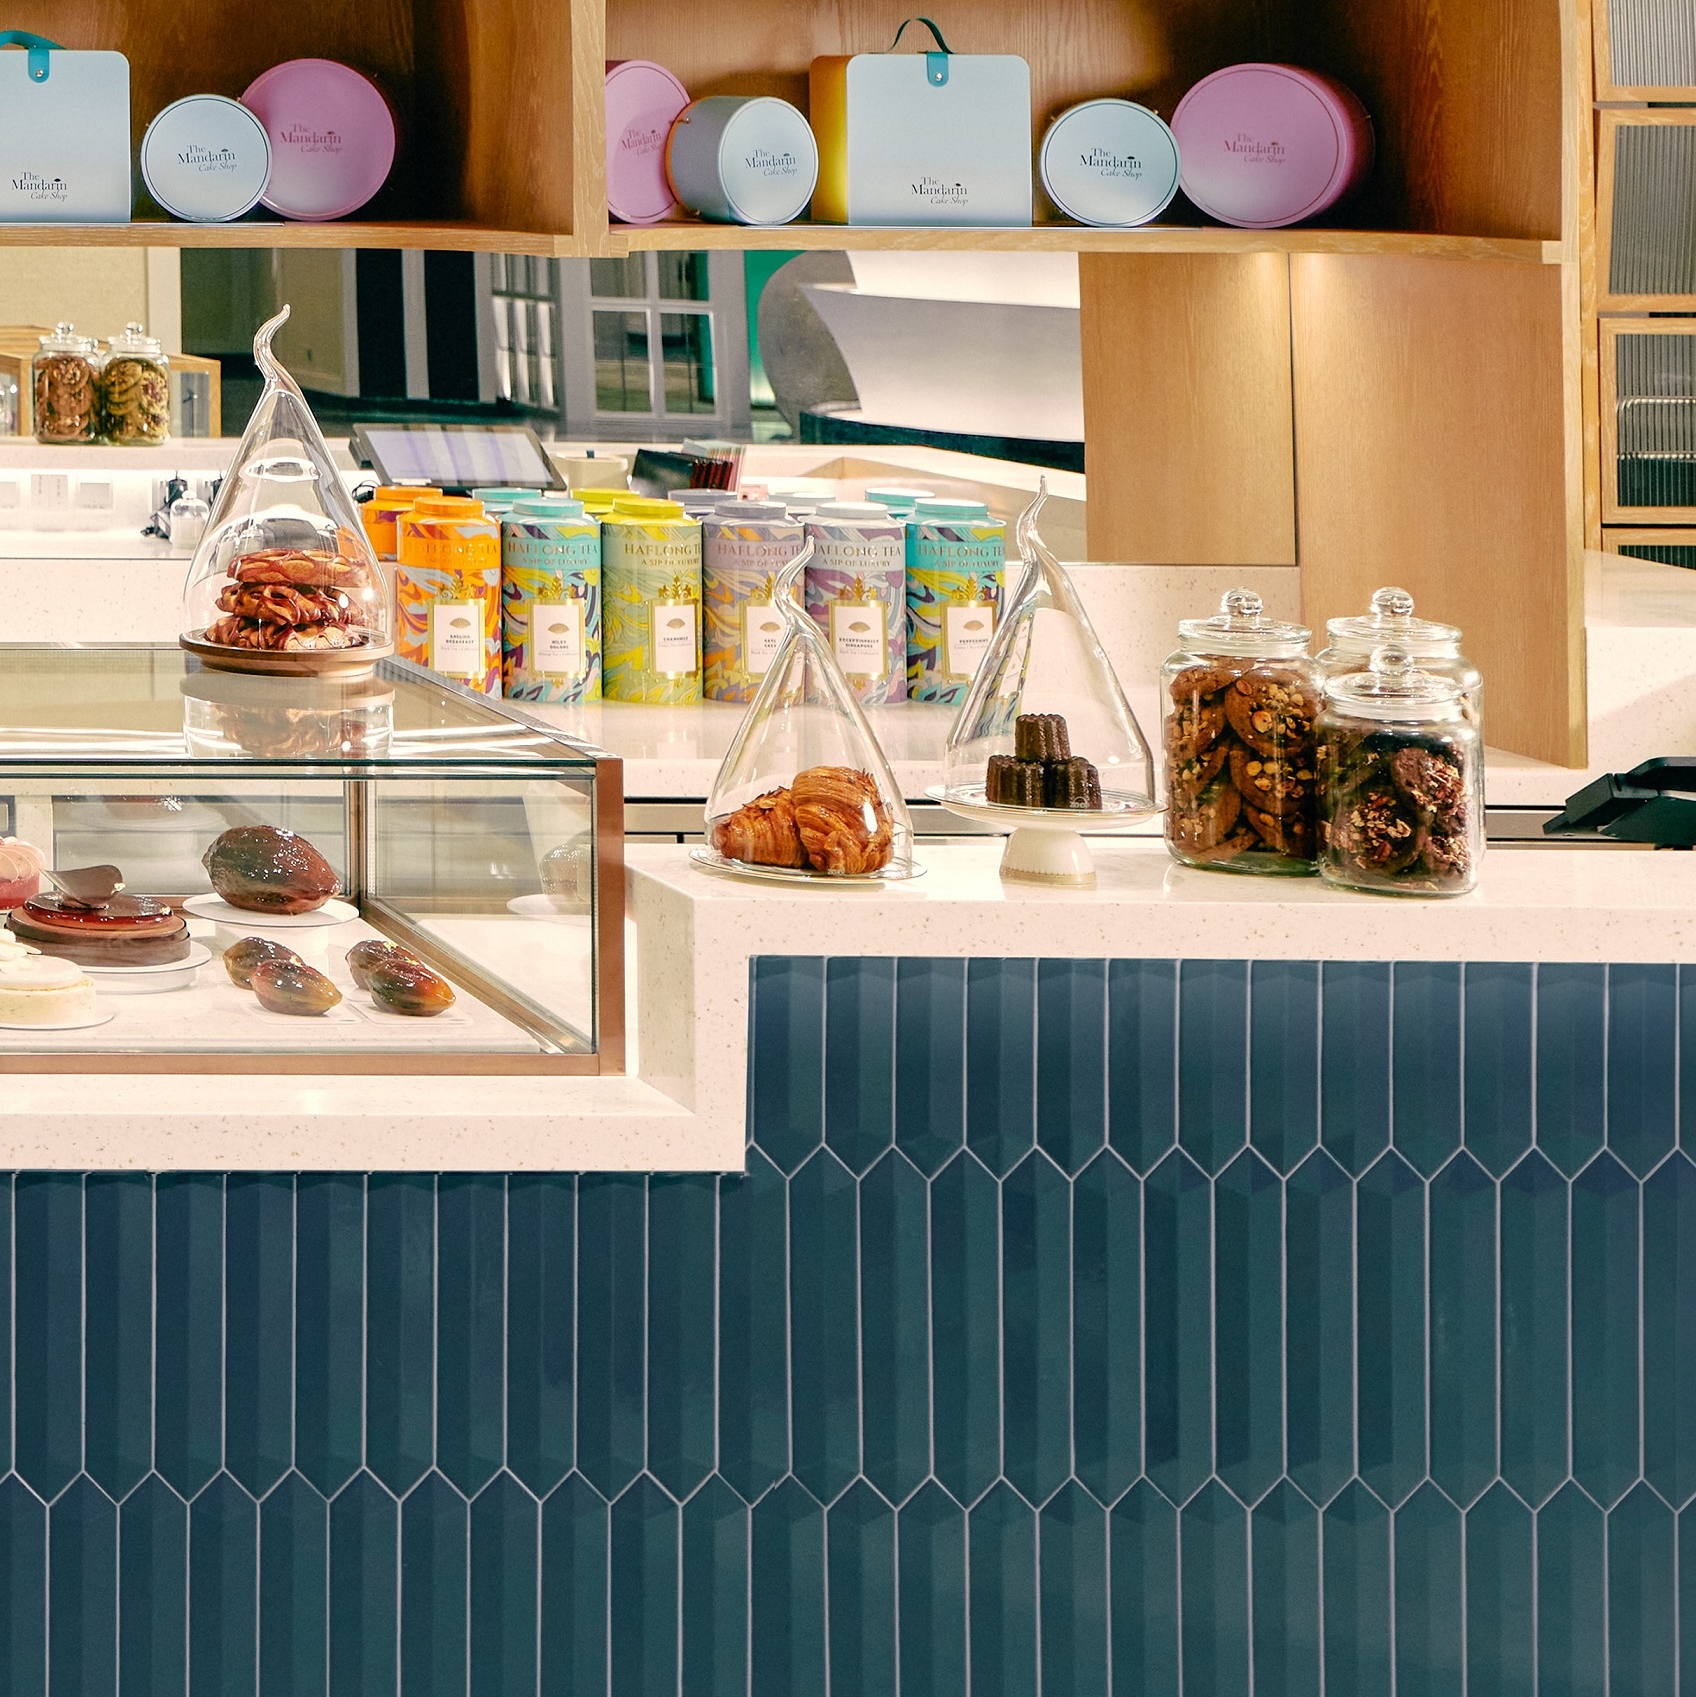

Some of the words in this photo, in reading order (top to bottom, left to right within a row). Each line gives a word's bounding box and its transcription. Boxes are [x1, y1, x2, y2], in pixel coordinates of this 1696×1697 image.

[291, 123, 310, 133] The
[628, 127, 641, 138] The
[279, 129, 342, 145] Mandarin
[621, 128, 662, 151] Mandarin
[1235, 133, 1254, 142] The
[188, 144, 206, 154] The
[300, 145, 321, 154] Cake
[322, 145, 343, 156] Shop
[635, 146, 648, 157] Cake
[1091, 148, 1110, 157] The
[1223, 139, 1285, 155] Mandarin
[177, 147, 236, 165] Mandarin
[755, 148, 770, 158] The
[745, 152, 797, 169] Mandarin
[1079, 153, 1142, 169] Mandarin
[1244, 155, 1264, 164] Cake
[1266, 155, 1286, 166] Shop
[197, 163, 216, 172] Cake
[218, 161, 237, 172] Shop
[762, 167, 779, 176] Cake
[780, 166, 797, 177] Shop
[21, 171, 39, 180] The
[1100, 169, 1121, 178] Cake
[1122, 169, 1143, 180] Shop
[11, 177, 67, 191] Mandarin
[921, 176, 939, 185] The
[911, 182, 967, 196] Mandarin
[30, 192, 48, 200] Cake
[50, 191, 68, 201] Shop
[930, 196, 948, 204] Cake
[950, 196, 968, 206] Shop
[508, 542, 575, 555] HAFLONG
[581, 543, 597, 554] TEA
[625, 544, 692, 556] HAFLONG
[718, 545, 787, 557] HAFLONG
[882, 544, 901, 556] TEA
[919, 544, 989, 556] HAFLONG
